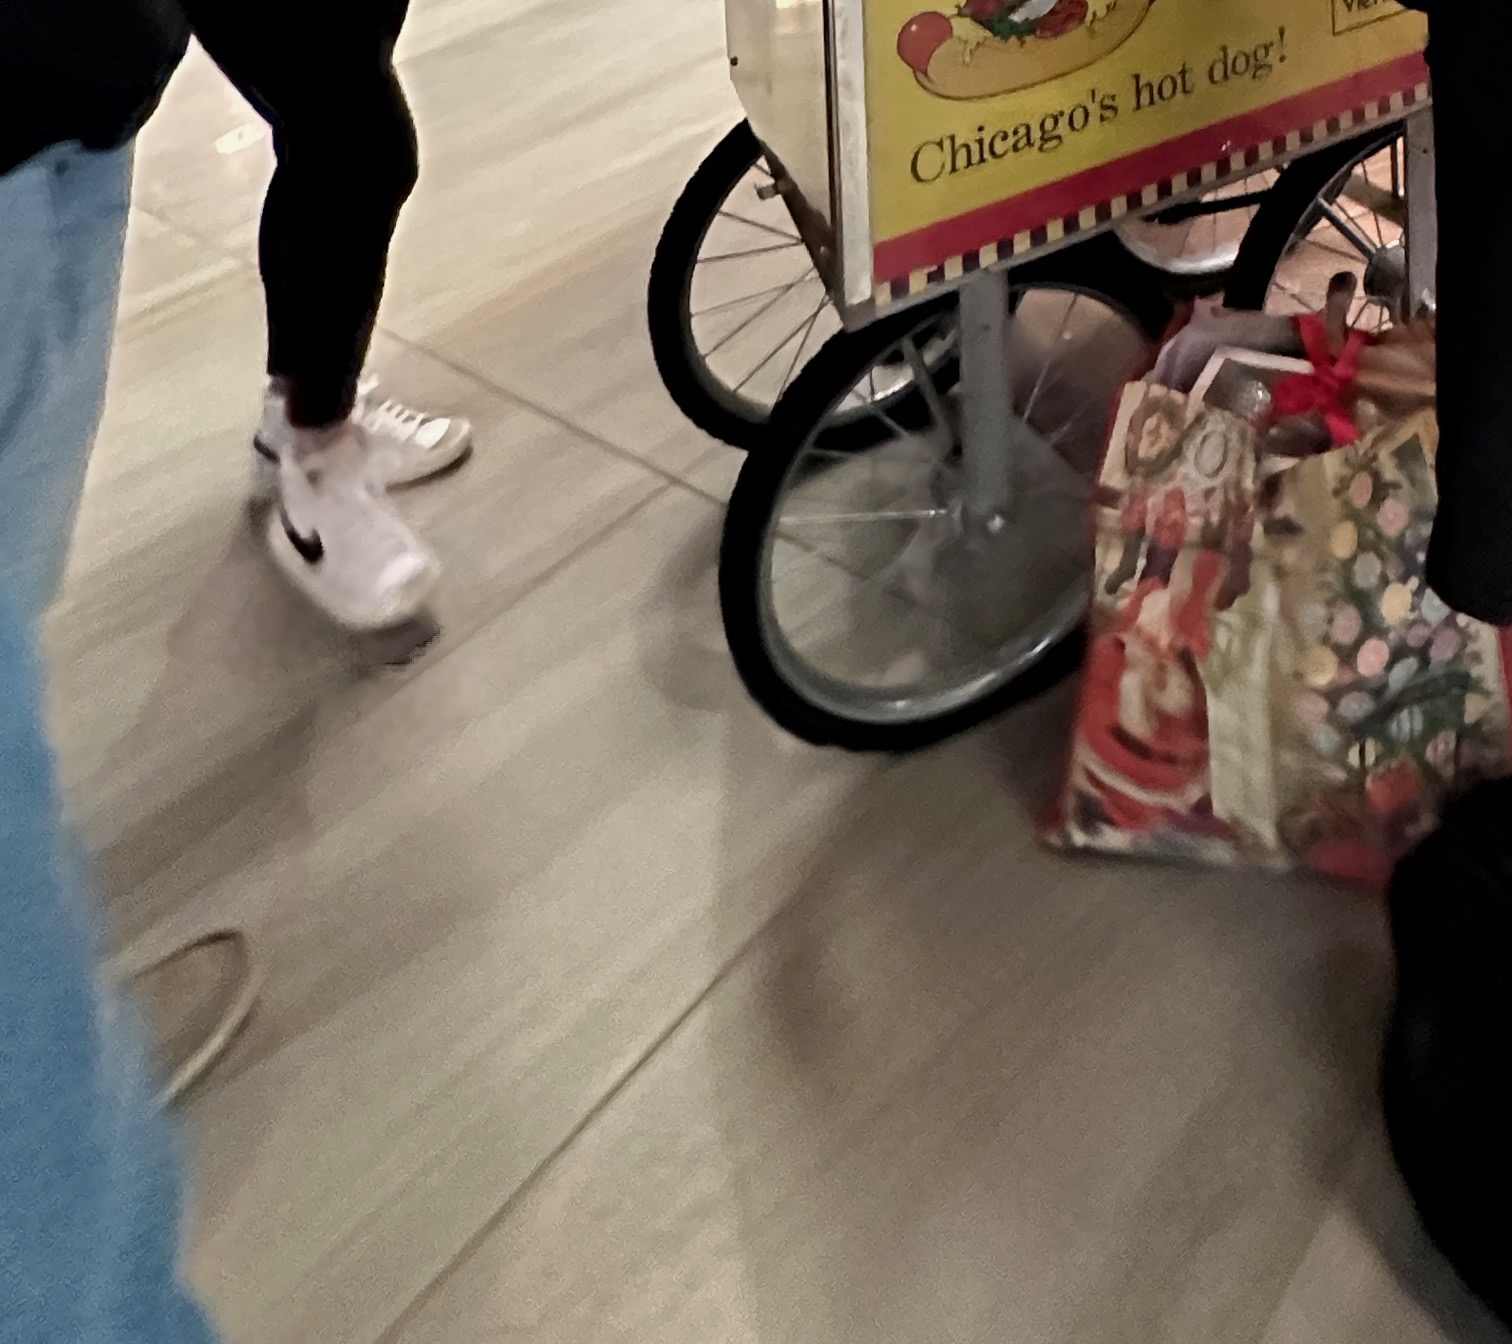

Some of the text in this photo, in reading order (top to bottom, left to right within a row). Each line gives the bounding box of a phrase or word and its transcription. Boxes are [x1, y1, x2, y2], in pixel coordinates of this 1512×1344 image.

[910, 25, 1288, 184] Chicago's hot dog!
